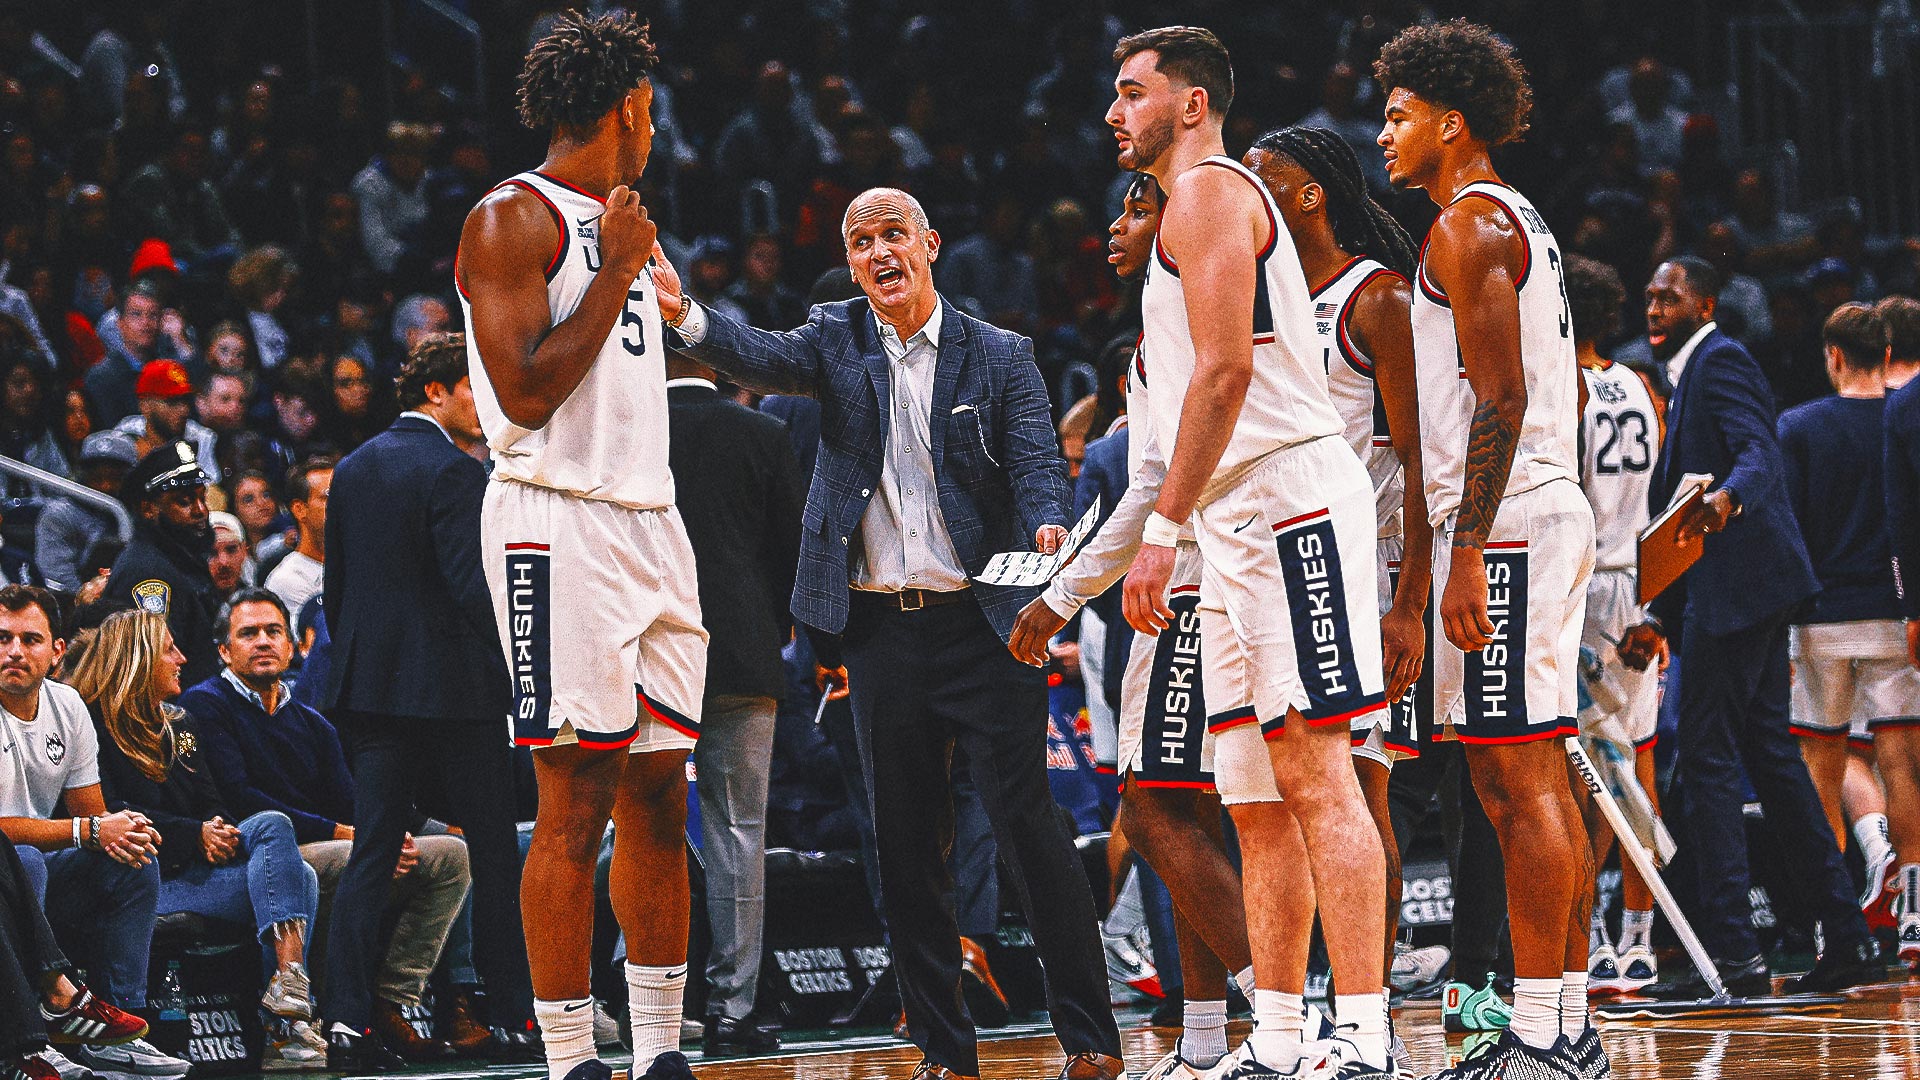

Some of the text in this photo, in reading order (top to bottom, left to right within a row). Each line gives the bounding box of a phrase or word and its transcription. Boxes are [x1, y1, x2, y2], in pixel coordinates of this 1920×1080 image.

[621, 290, 646, 356] 5
[1596, 410, 1650, 474] 23
[513, 563, 536, 720] HUSKIES
[1297, 533, 1348, 696] HUSKIES
[1482, 562, 1511, 718] HUSKIES
[1160, 611, 1201, 765] HUSKIES
[852, 945, 891, 969] BOS
[188, 1010, 242, 1036] STON
[188, 1035, 247, 1062] ELTICS
